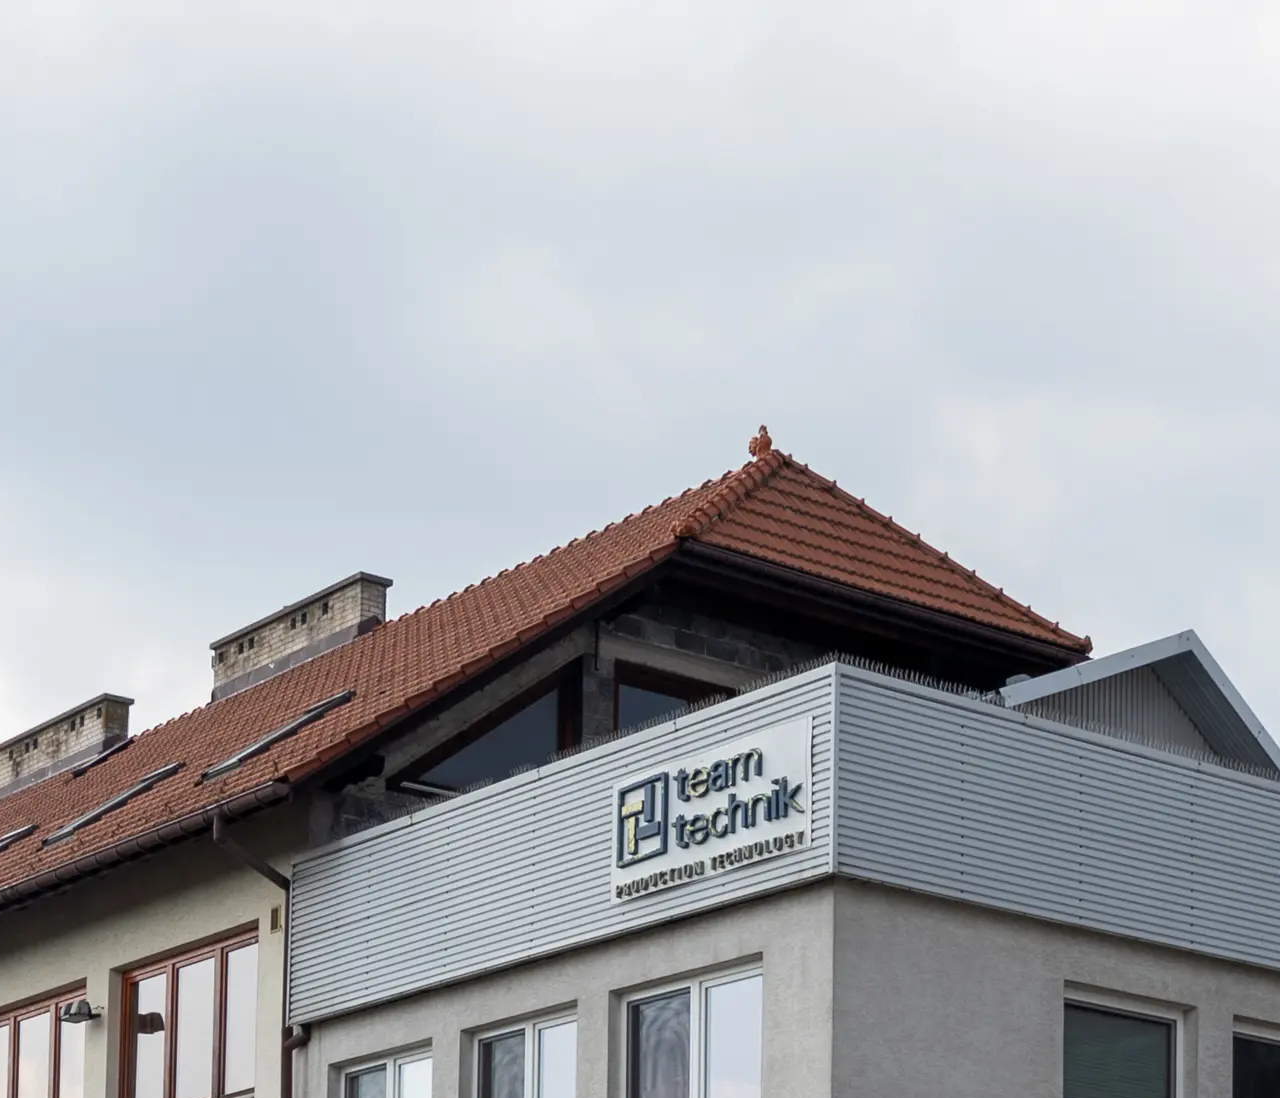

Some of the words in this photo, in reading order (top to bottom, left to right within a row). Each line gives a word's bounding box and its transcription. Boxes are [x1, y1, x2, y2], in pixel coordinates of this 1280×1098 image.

[673, 747, 763, 802] team
[672, 776, 805, 849] technik
[616, 860, 705, 899] PRODUCTION
[710, 831, 805, 871] TECHNOLOGY
